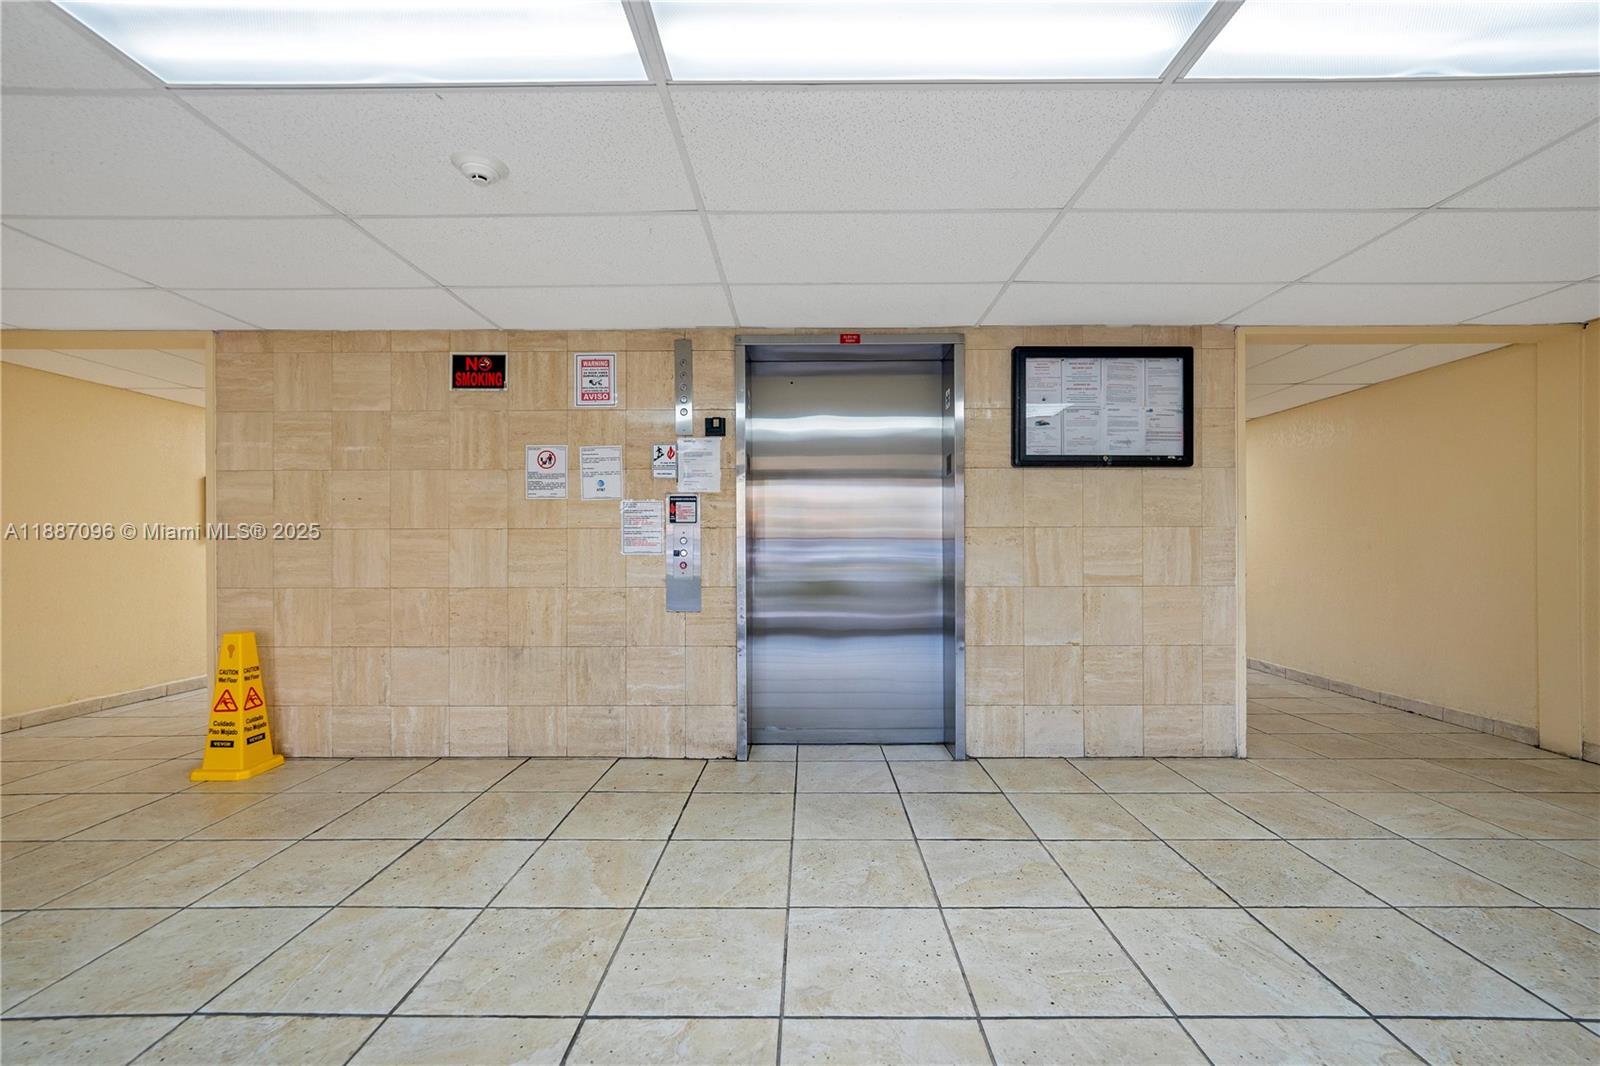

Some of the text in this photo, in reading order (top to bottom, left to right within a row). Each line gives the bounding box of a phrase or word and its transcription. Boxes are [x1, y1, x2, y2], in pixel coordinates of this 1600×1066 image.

[465, 356, 493, 371] NO
[455, 371, 503, 387] SMOKING
[246, 715, 264, 723] Cuidado
